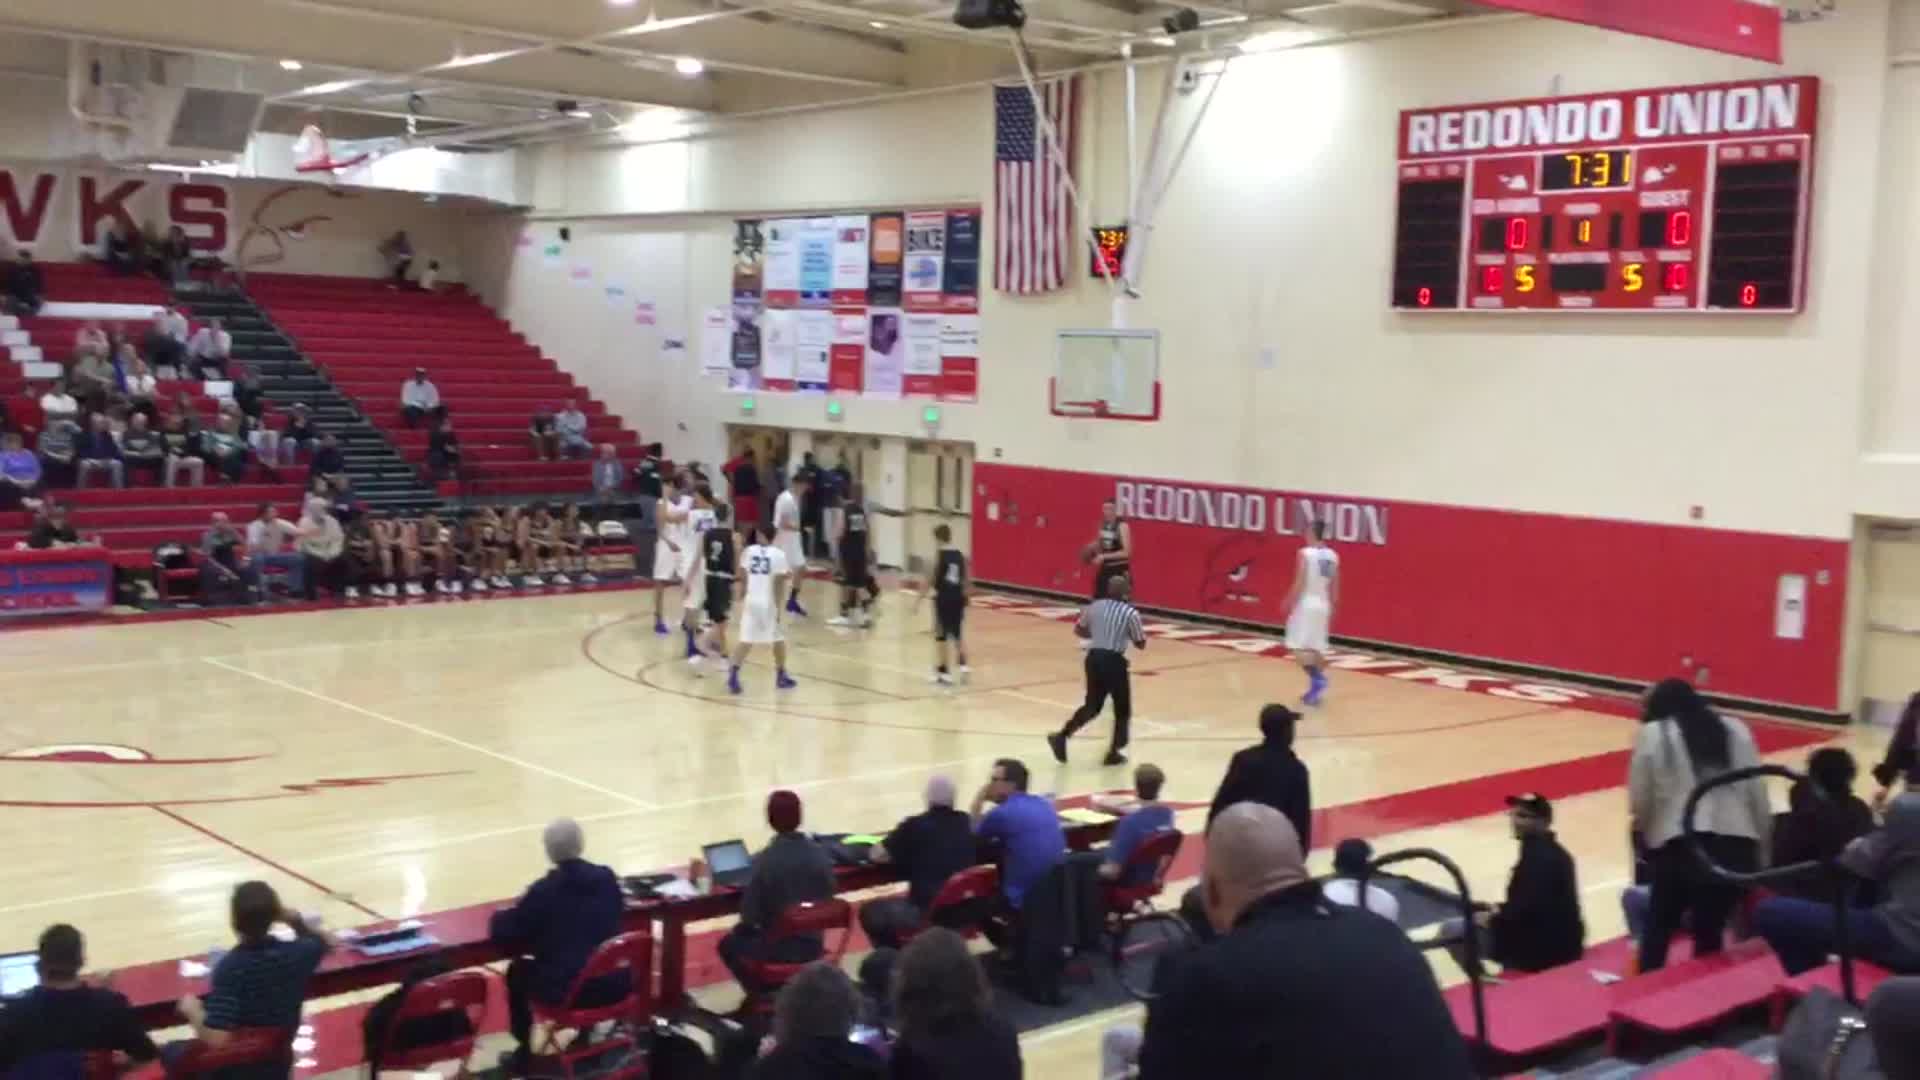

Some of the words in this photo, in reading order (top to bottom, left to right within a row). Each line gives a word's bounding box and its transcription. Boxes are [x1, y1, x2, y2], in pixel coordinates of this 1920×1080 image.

[1407, 99, 1622, 154] REDONDO
[1634, 84, 1799, 138] UNION
[1565, 151, 1632, 188] 7:31
[1508, 218, 1528, 249] 0
[1671, 212, 1690, 245] 0
[1514, 265, 1535, 292] 5
[1623, 263, 1643, 292] 5
[1417, 287, 1431, 305] 0
[1742, 285, 1756, 305] 0
[1116, 481, 1266, 532] REDONDO
[1274, 496, 1388, 545] UNION
[750, 556, 771, 575] 23
